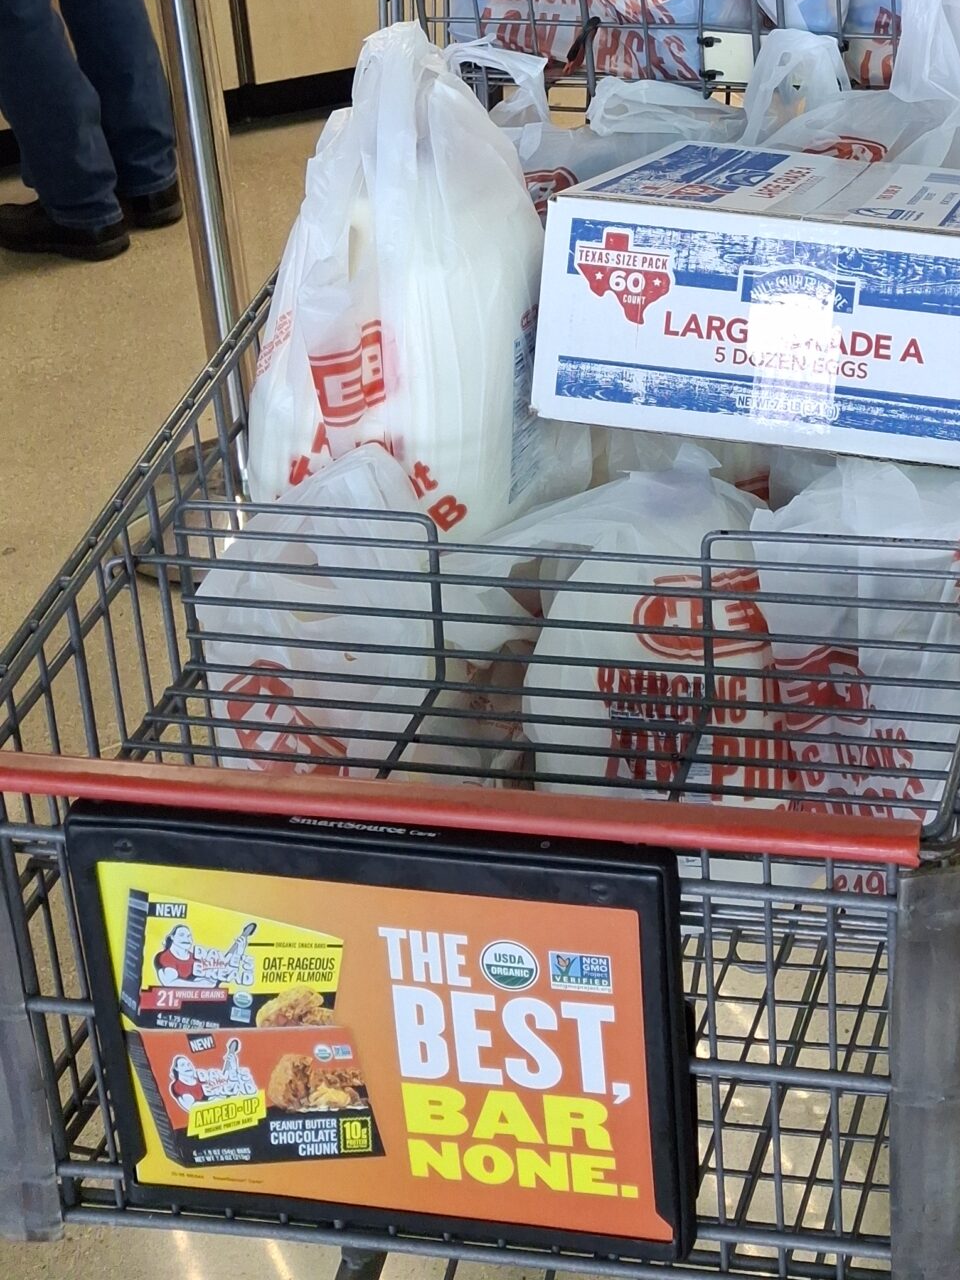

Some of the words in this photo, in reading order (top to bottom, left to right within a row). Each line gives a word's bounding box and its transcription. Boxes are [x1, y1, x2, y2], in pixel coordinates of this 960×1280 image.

[578, 249, 638, 268] TEXAS-SIZE
[641, 256, 669, 270] PACK
[609, 271, 646, 293] 60
[622, 294, 646, 305] COUNT
[663, 311, 749, 345] LARG
[899, 337, 925, 365] A
[714, 347, 726, 364] 5
[732, 348, 806, 372] DOZEN
[813, 357, 868, 380] EGGS
[289, 816, 407, 835] SmartSource
[155, 903, 187, 918] NEW!
[275, 941, 297, 949] ORGANIC
[262, 956, 335, 971] OAT-RAGEOUS
[378, 926, 472, 987] THE
[493, 952, 525, 965] USDA
[582, 957, 608, 966] NON
[490, 966, 530, 978] ORGANIC
[582, 964, 608, 972] GMO
[582, 970, 608, 979] Project
[261, 971, 293, 983] HONEY
[296, 970, 334, 983] ALMOND
[555, 976, 609, 986] VERIFIED
[175, 990, 200, 1000] WHOLE
[200, 990, 225, 1000] GRAINS
[189, 1036, 214, 1051] NEW!
[391, 984, 632, 1105] BEST,
[195, 1097, 260, 1128] AMPED-UP
[401, 1082, 614, 1151] BAR
[270, 1120, 303, 1131] PEANUT
[305, 1118, 337, 1129] BUTTER
[270, 1129, 338, 1145] CHOCOLATE
[298, 1142, 339, 1157] CHUNK
[408, 1138, 639, 1200] NONE.
